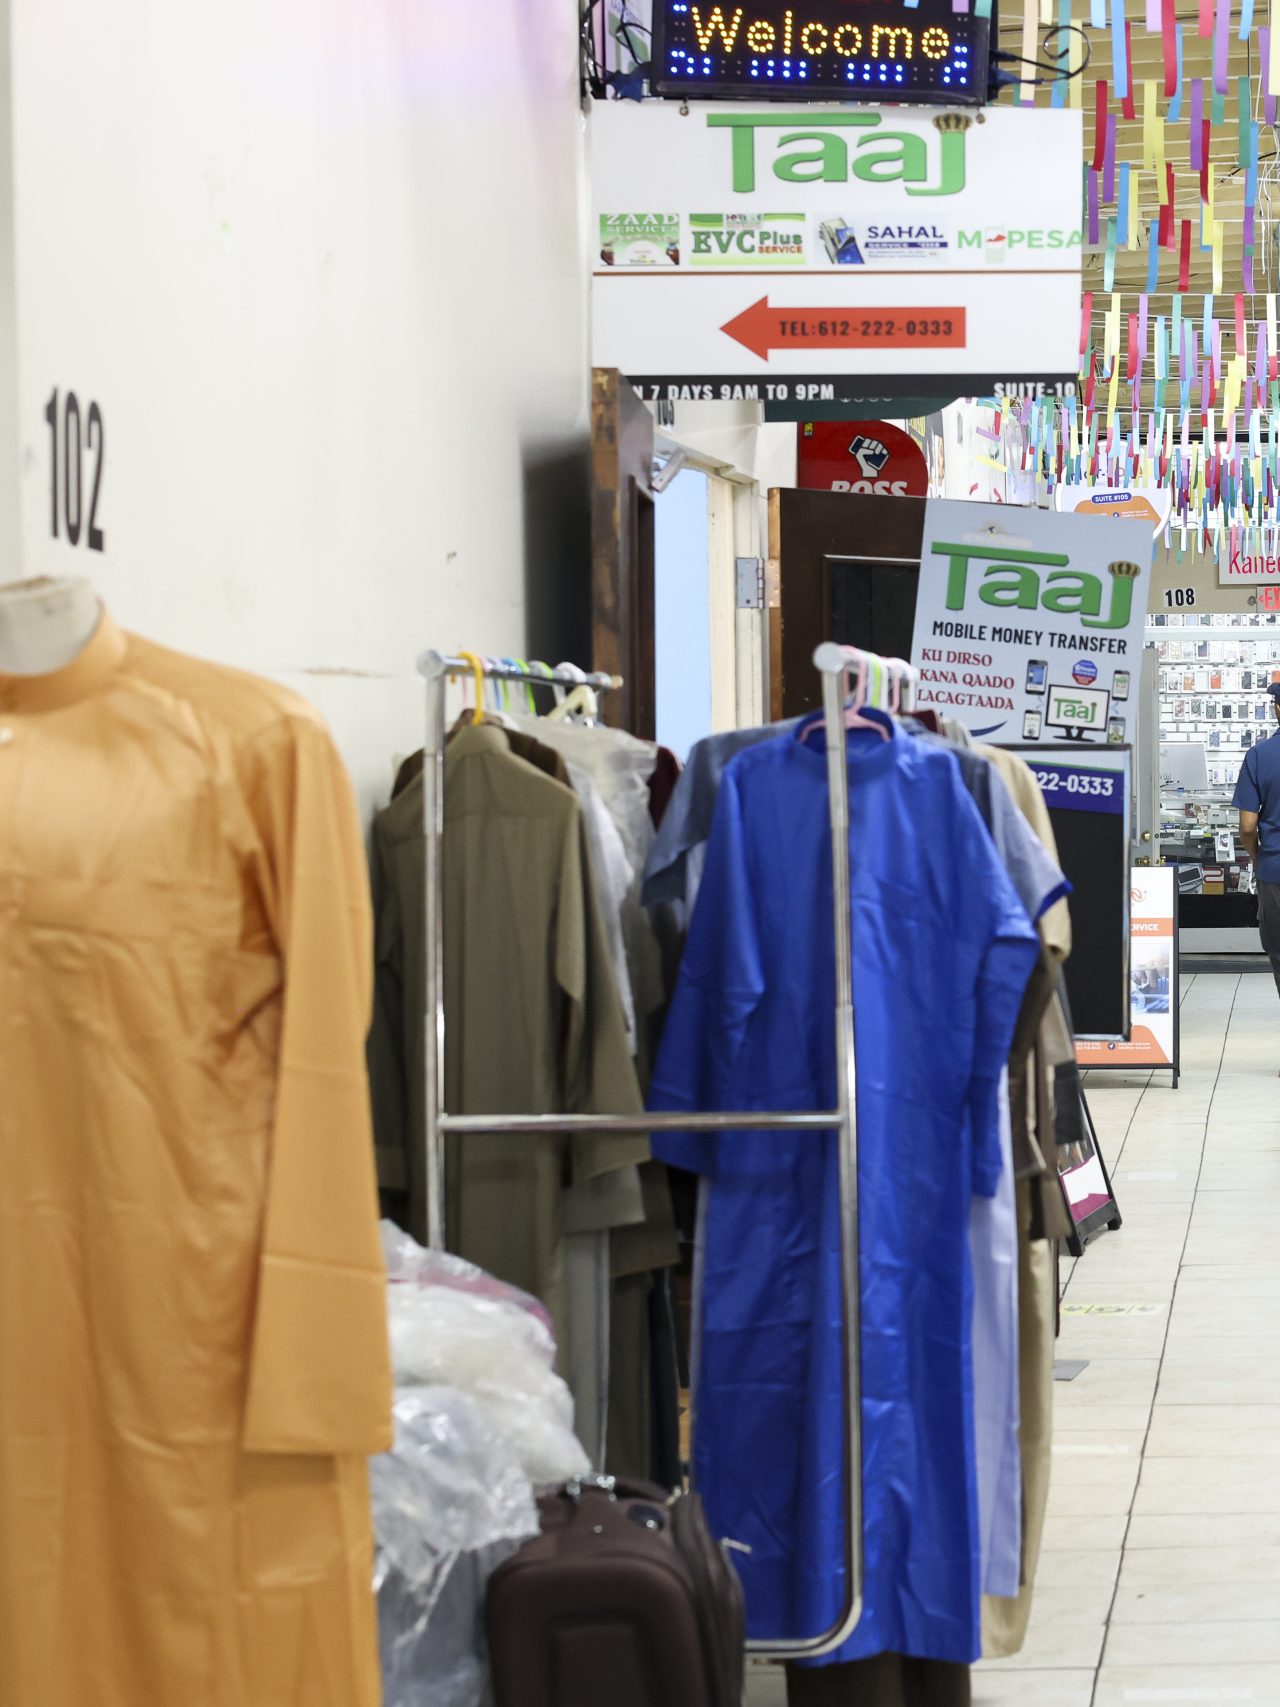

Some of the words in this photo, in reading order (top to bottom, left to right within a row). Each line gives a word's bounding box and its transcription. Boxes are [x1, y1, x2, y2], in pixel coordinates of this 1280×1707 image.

[691, 6, 950, 59] Welcome
[706, 112, 966, 197] Taaj
[606, 214, 679, 226] ZAAD
[691, 230, 756, 254] EVC
[759, 231, 803, 245] Plus
[867, 226, 944, 239] SAHAL
[758, 245, 803, 254] SERVICE
[779, 320, 953, 336] TEL:612-222-0333
[650, 384, 660, 400] 7
[667, 384, 713, 400] DAYS
[719, 384, 759, 400] 9AM
[766, 384, 788, 400] TO
[795, 384, 834, 400] 9PM
[45, 385, 104, 552] 102
[1094, 495, 1113, 503] SUITE
[931, 541, 1135, 630] Taaj
[1165, 588, 1196, 607] 108
[931, 620, 988, 641] MOBILE
[991, 626, 1044, 647] MONEY
[1049, 632, 1128, 655] TRANSFER
[921, 648, 943, 662] KU
[946, 650, 993, 667] DIRSO
[919, 668, 958, 684] KANA
[962, 673, 1015, 690] QAADO
[917, 689, 1015, 710] LACAGTAADA
[1053, 697, 1097, 724] Taaj
[1032, 770, 1114, 796] 22-0333
[1131, 923, 1159, 931] ERVICE
